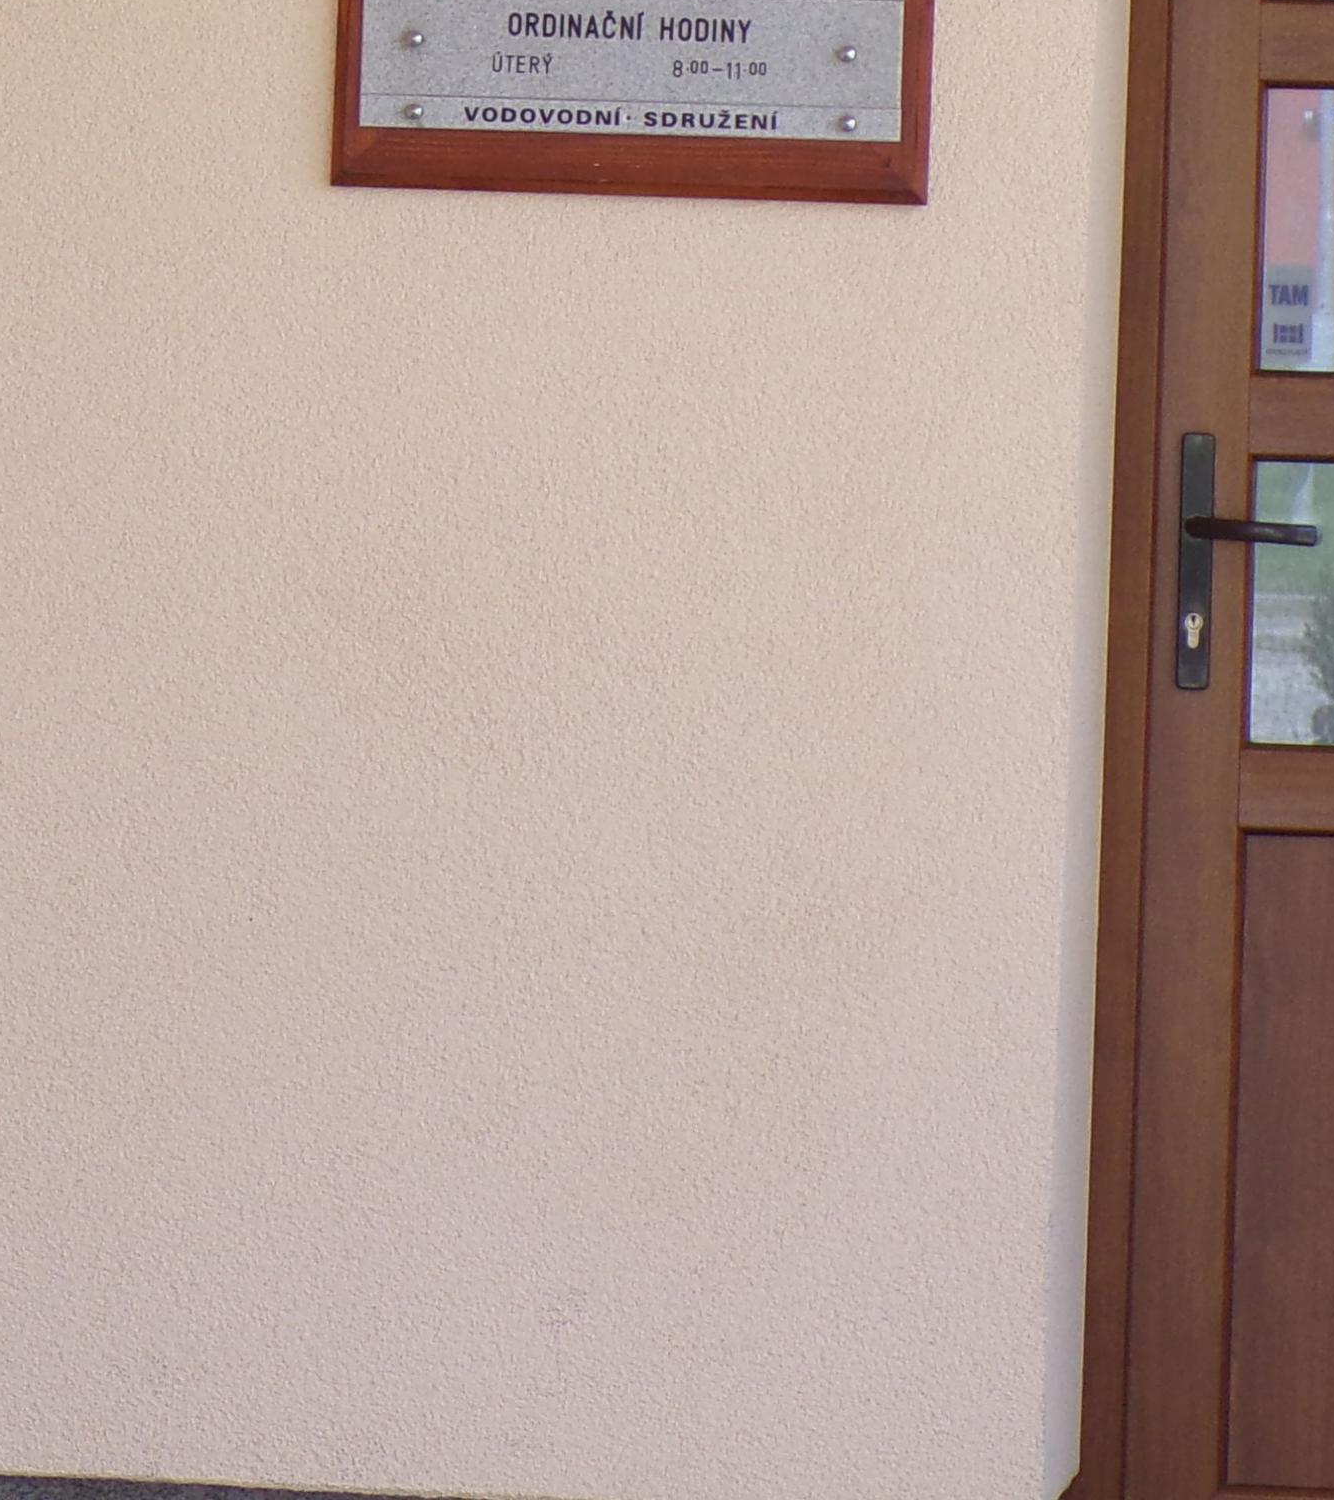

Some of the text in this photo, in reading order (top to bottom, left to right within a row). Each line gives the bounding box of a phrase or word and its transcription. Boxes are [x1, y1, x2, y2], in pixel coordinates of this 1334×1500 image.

[506, 10, 753, 45] ORDINAČNÍ HODINY
[490, 50, 554, 76] ÚTERÝ
[643, 109, 779, 132] SDRUŽENÍ
